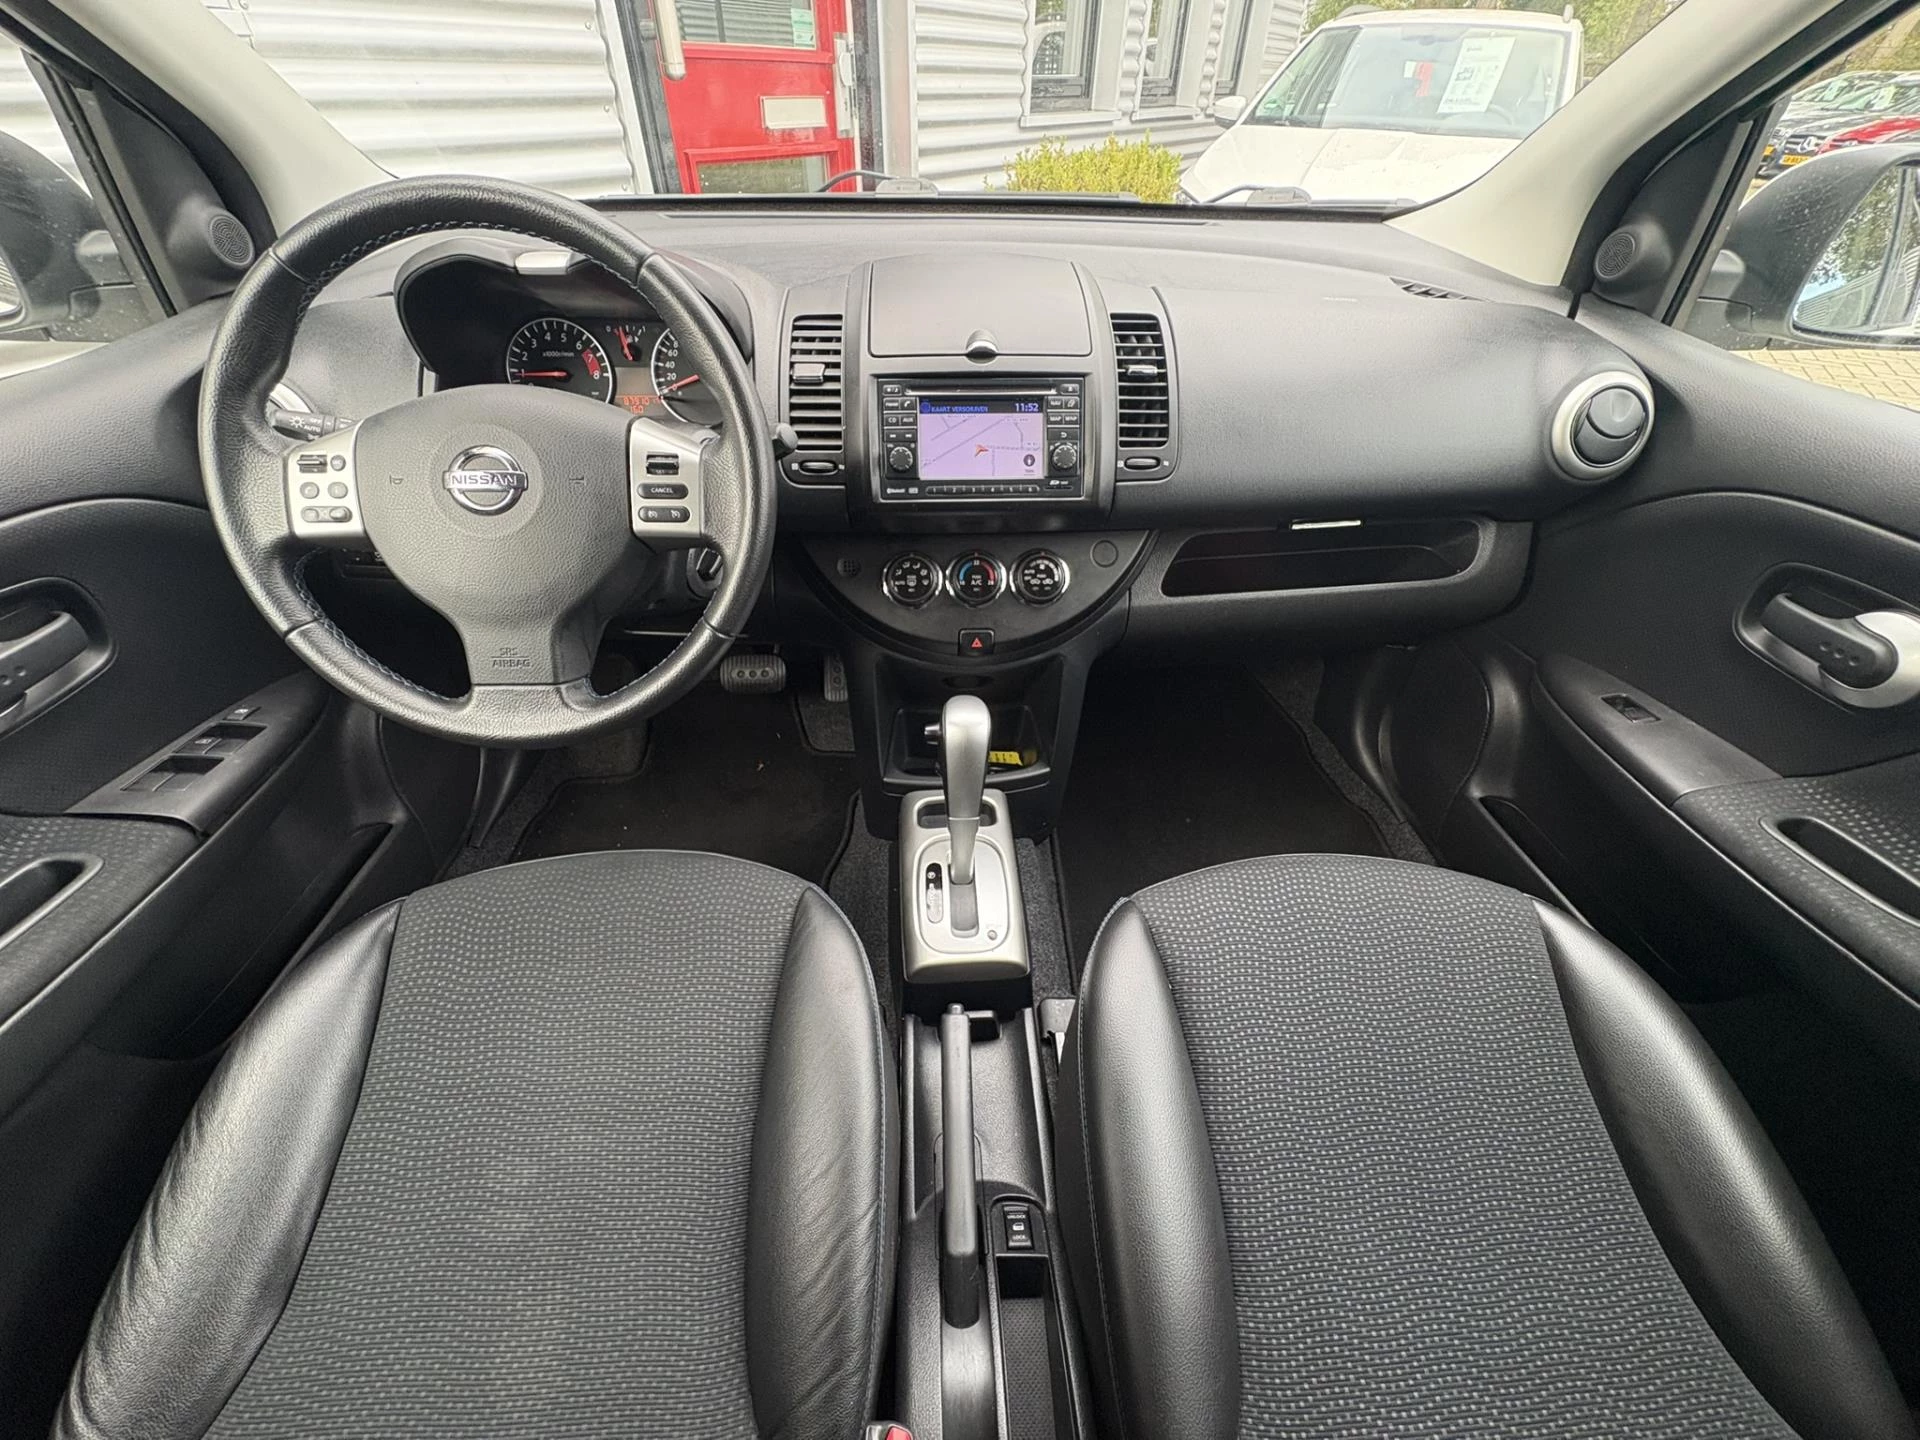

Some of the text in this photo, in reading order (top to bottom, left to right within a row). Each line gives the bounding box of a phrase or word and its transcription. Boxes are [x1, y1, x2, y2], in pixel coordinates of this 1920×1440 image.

[544, 332, 551, 341] 4
[560, 333, 567, 342] 5
[531, 339, 537, 348] 3
[576, 341, 582, 350] 6
[522, 352, 528, 361] 2
[588, 354, 593, 362] 7
[593, 370, 600, 380] 8
[1015, 403, 1039, 412] 11:52
[451, 473, 518, 486] NISSAN
[500, 647, 518, 656] SRS
[492, 658, 530, 668] AIRBAG
